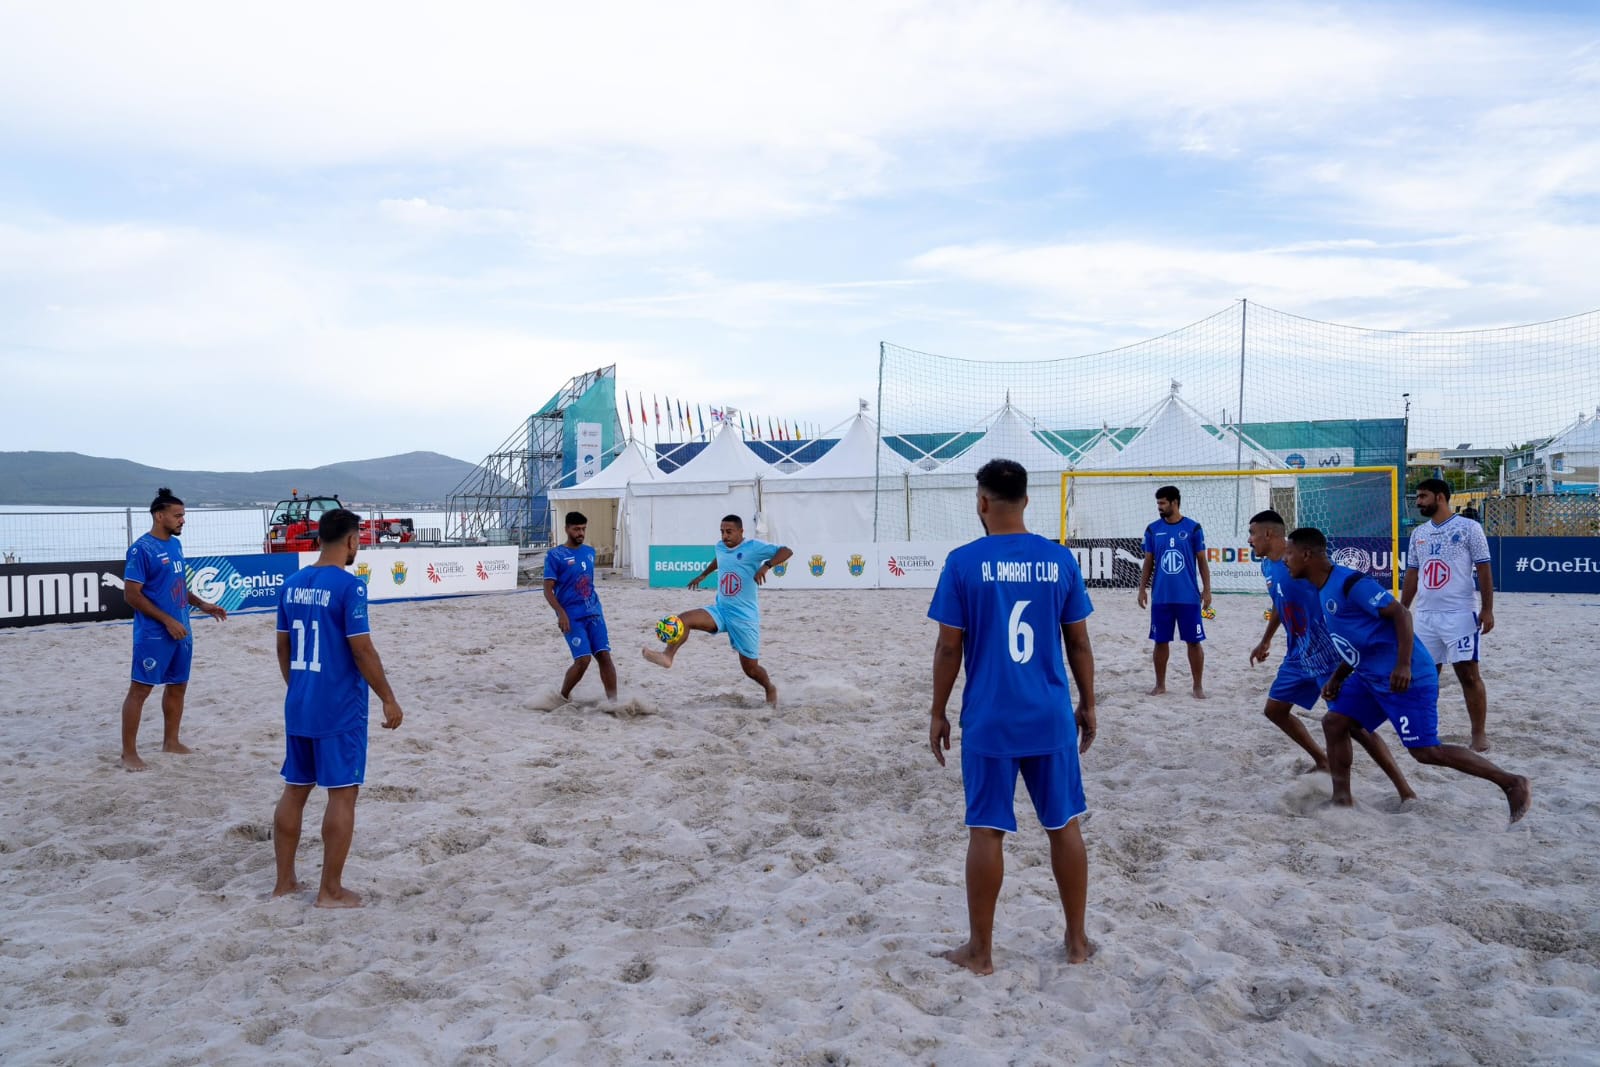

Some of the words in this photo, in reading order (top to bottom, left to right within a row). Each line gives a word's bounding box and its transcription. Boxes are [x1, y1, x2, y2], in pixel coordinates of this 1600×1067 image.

[1430, 543, 1441, 555] 12
[173, 560, 183, 573] 10
[484, 563, 509, 571] ALGHERO
[581, 561, 587, 571] 9
[1161, 549, 1185, 574] MG
[1515, 556, 1600, 573] #OneHu
[436, 565, 464, 574] ALGHERO
[982, 561, 995, 582] AL
[997, 561, 1033, 582] AMARAT
[1035, 561, 1060, 582] CLUB
[1423, 559, 1451, 590] MG
[228, 571, 284, 589] Genius
[239, 588, 276, 599] SPORTS
[1008, 600, 1034, 664] 6
[1196, 624, 1202, 634] 8
[290, 619, 322, 673] 11
[1457, 636, 1471, 649] 12
[1399, 715, 1410, 734] 2
